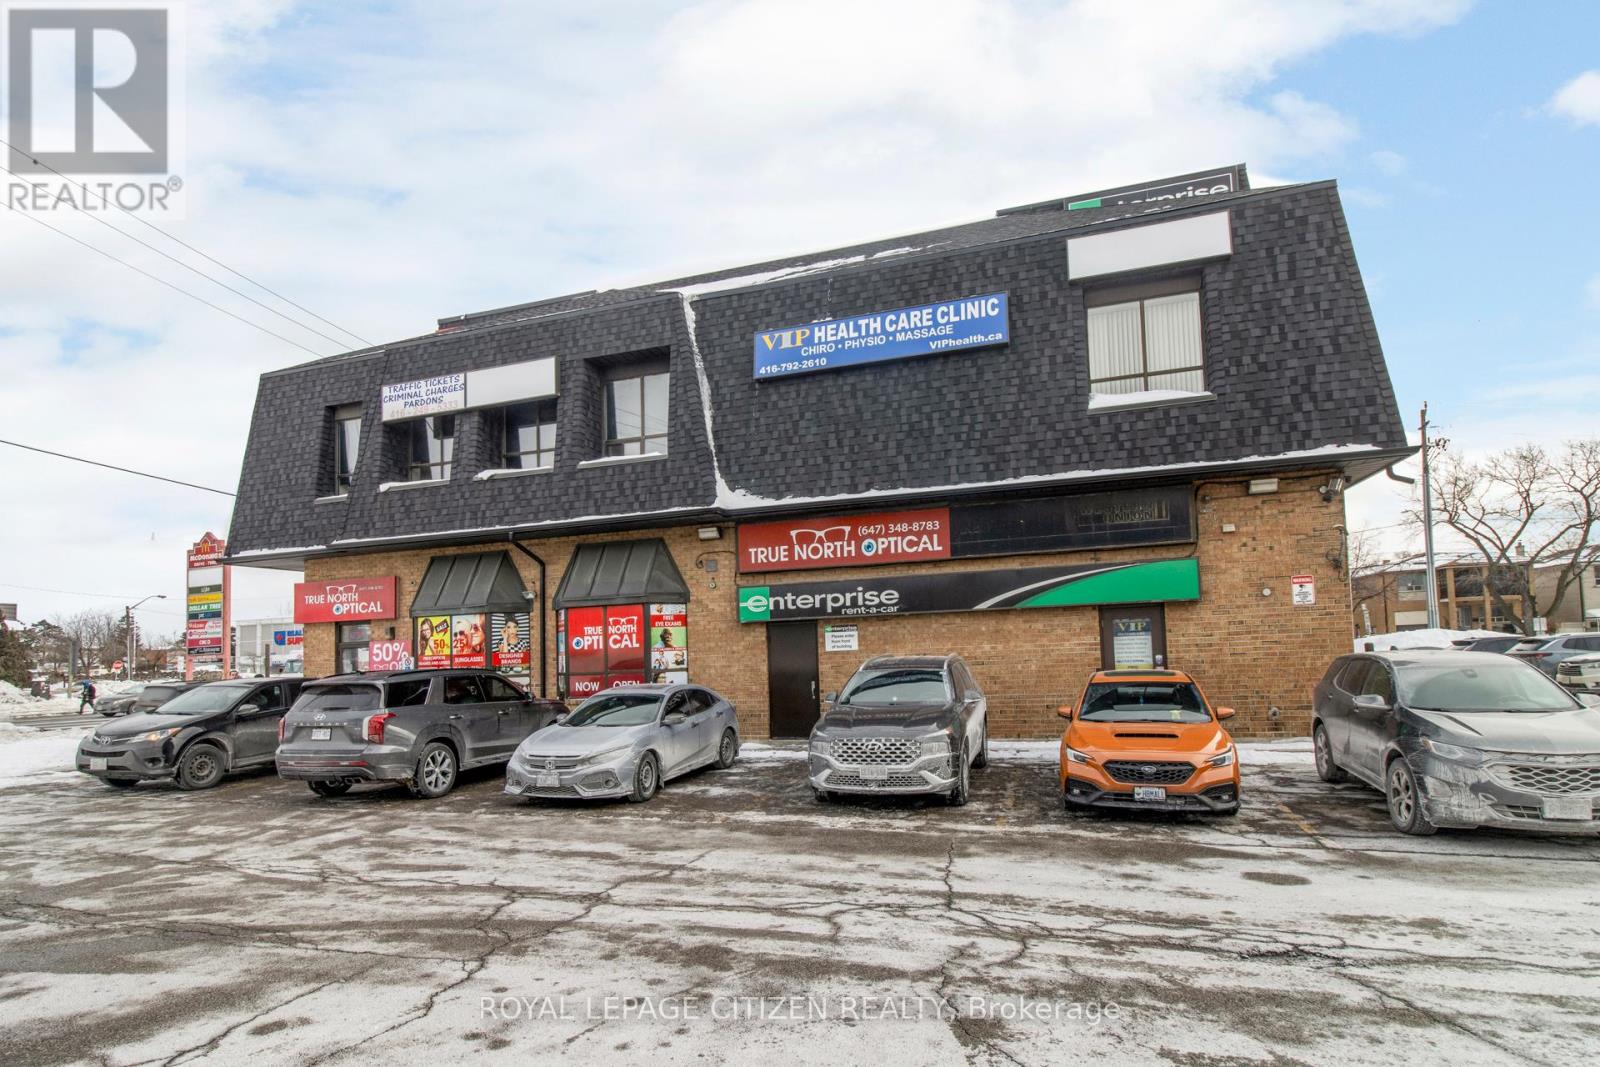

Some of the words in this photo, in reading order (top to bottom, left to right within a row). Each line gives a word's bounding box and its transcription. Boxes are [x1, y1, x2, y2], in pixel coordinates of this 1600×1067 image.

[761, 328, 809, 351] VIP
[814, 316, 881, 343] HEALTH
[885, 308, 933, 332] CARE
[936, 297, 1000, 323] CLINIC
[801, 342, 836, 357] CHIRO
[844, 335, 886, 350] PHYSIO
[896, 325, 954, 342] MASSAGE
[929, 332, 1003, 350] VIPhealth.ca
[759, 357, 827, 375] 416-792-2610
[383, 390, 423, 403] CRIMINAL
[425, 383, 465, 396] CHARGES
[388, 381, 422, 394] TRAFFIC
[424, 375, 460, 388] TICKETS
[403, 395, 444, 408] PARDONS
[858, 524, 885, 536] (647)
[888, 521, 940, 533] 348-8783
[749, 546, 789, 563] TRUE
[794, 541, 856, 560] NORTH
[861, 534, 943, 556] OPTICAL
[304, 595, 325, 605] TRUE
[327, 593, 359, 603] NORTH
[333, 601, 383, 615] OPTICAL
[740, 586, 900, 613] enterprise
[841, 604, 900, 615] rent-a-car
[584, 626, 603, 636] TRUE
[608, 624, 637, 635] NORTH
[1119, 622, 1147, 631] VIP
[372, 642, 408, 661] 50%
[575, 681, 600, 692] NOW
